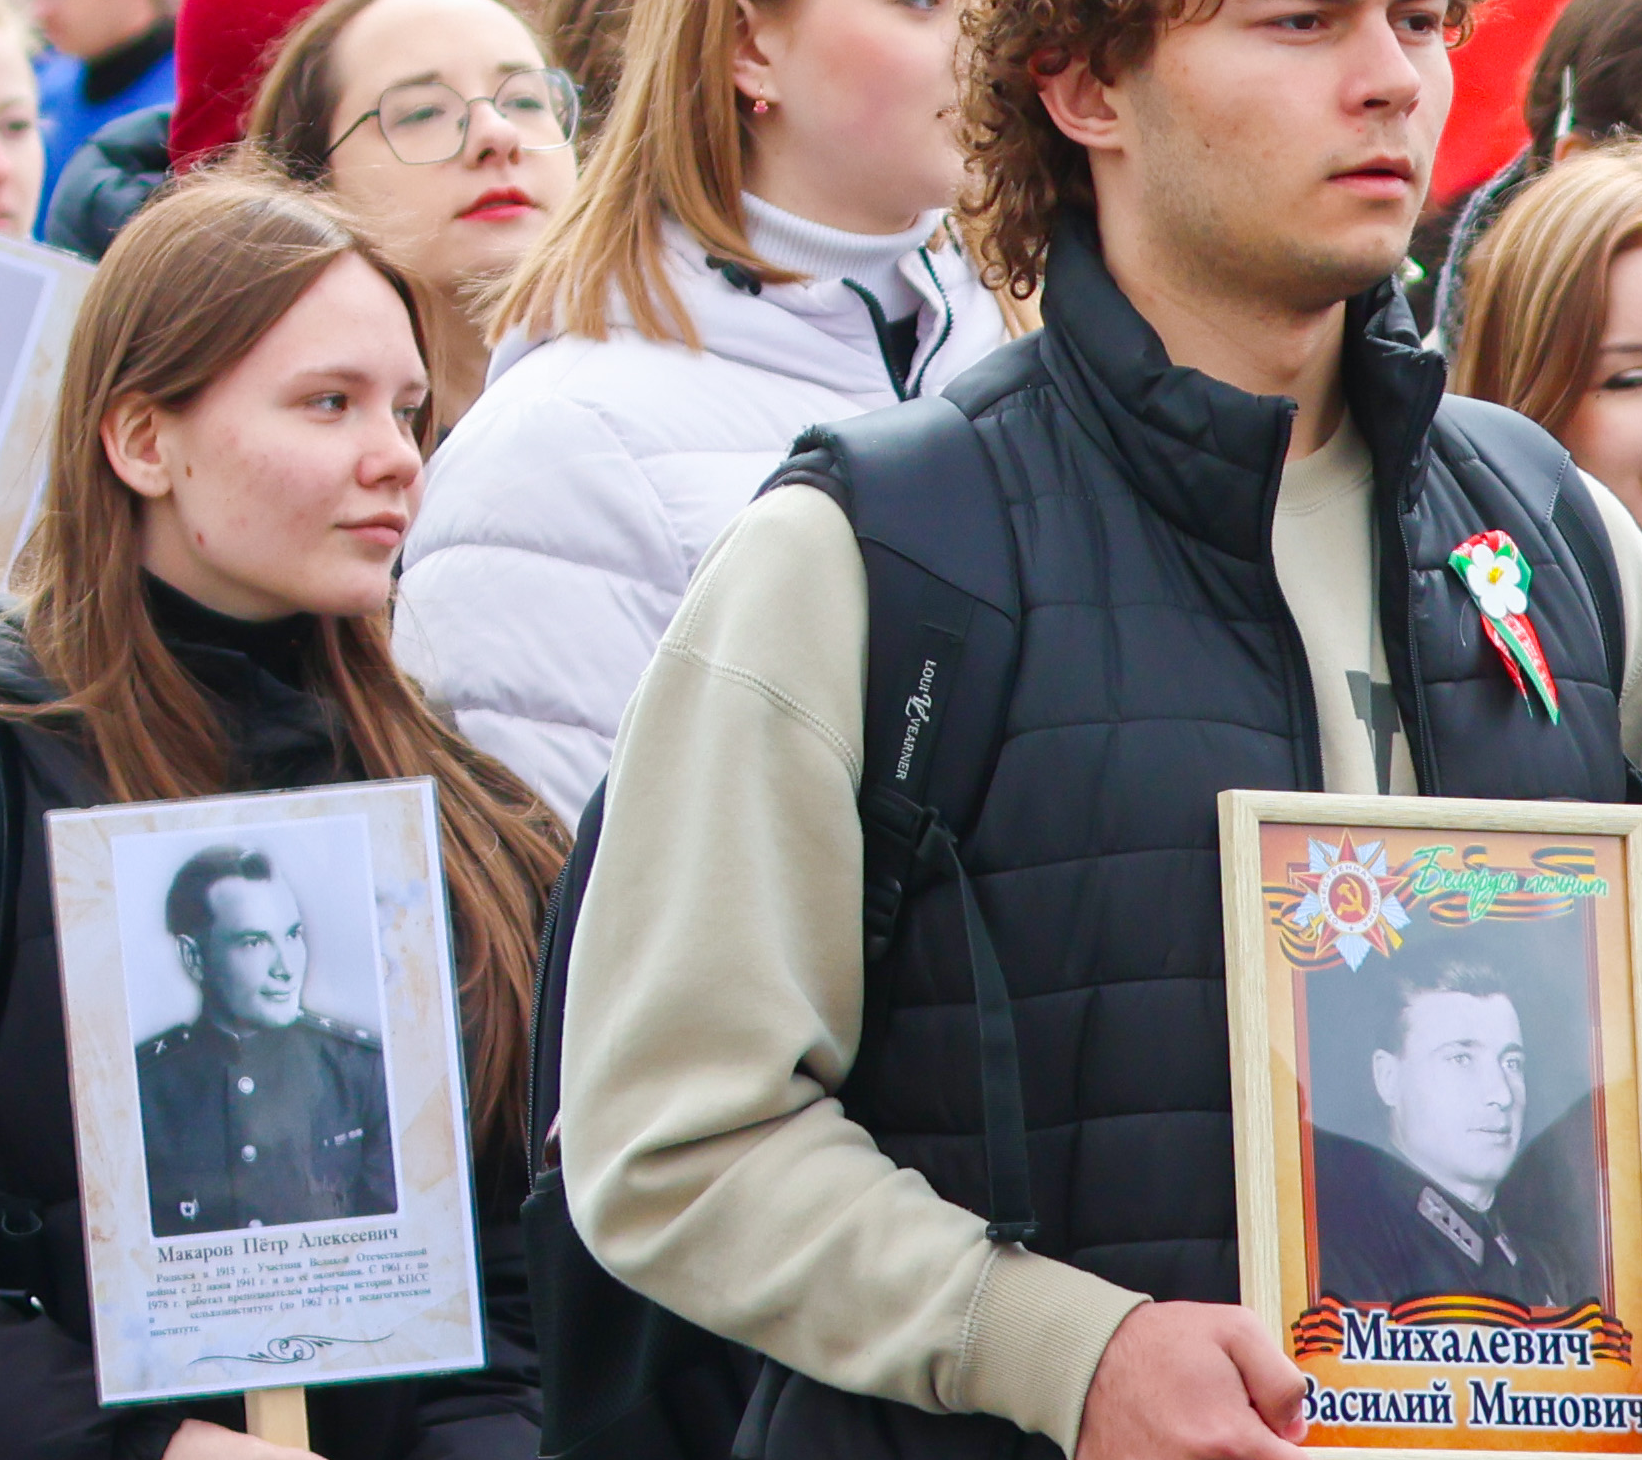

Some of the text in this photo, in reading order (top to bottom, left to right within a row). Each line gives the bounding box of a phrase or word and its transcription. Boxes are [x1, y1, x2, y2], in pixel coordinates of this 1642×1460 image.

[158, 1228, 399, 1263] Макаров Пётр Алексеевич
[1342, 1310, 1593, 1367] Михалевич
